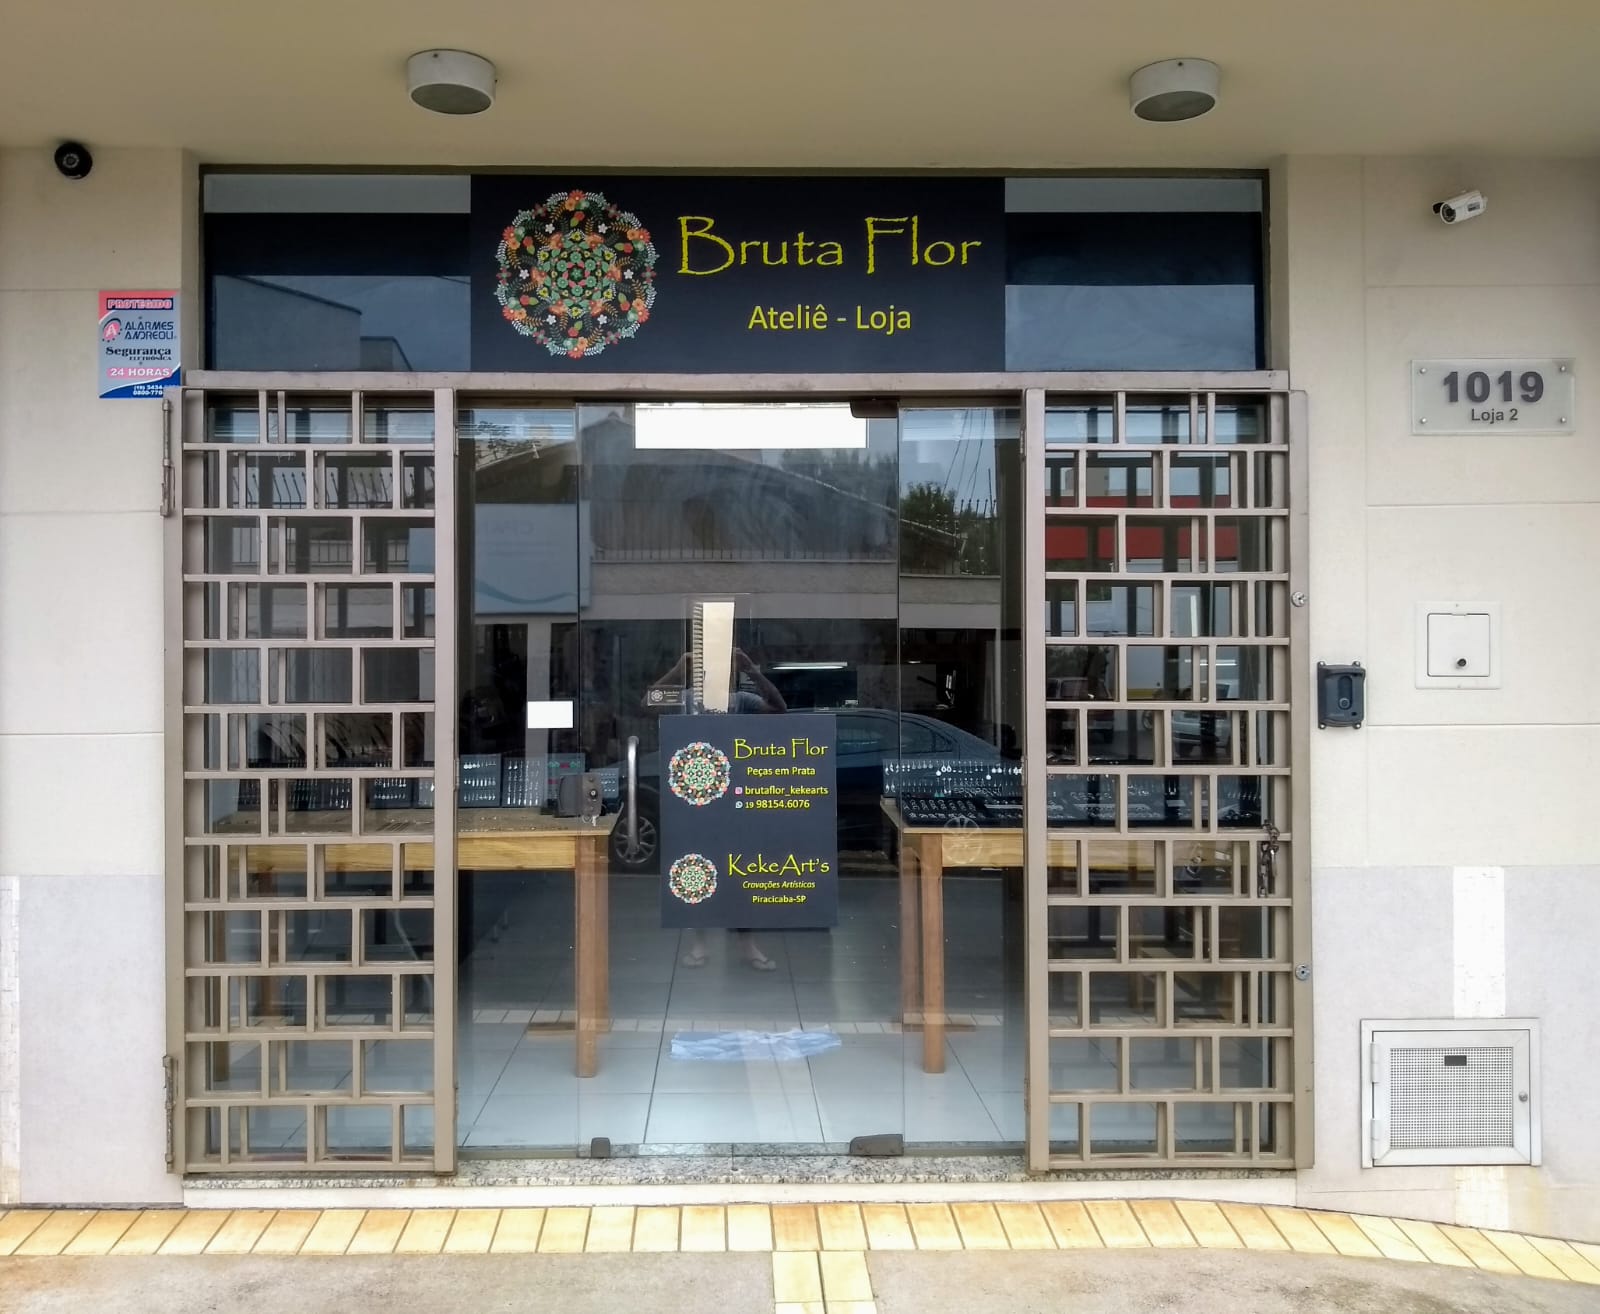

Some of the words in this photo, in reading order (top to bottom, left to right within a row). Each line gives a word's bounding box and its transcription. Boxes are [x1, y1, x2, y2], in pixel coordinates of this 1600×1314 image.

[677, 216, 844, 275] Bruta
[865, 215, 982, 275] Flor
[107, 299, 172, 309] PROTEGIDO
[748, 304, 828, 329] Ateliê
[856, 304, 912, 335] Loja
[125, 321, 174, 331] ALARMES
[106, 347, 171, 357] Segurança
[110, 368, 124, 376] 24
[128, 368, 170, 376] HORAS
[1443, 371, 1544, 403] 1019
[1471, 408, 1504, 424] Loja
[1509, 408, 1518, 421] 2
[735, 738, 786, 759] Bruta
[791, 737, 829, 758] Flor
[747, 766, 773, 777] Peças
[791, 766, 816, 775] Prata
[745, 785, 829, 797] brutaflor_kekearts
[745, 801, 754, 809] 19
[756, 799, 810, 809] 98154.6076
[728, 853, 830, 876] KekeArt's
[752, 895, 807, 903] Piracicaba-SP
